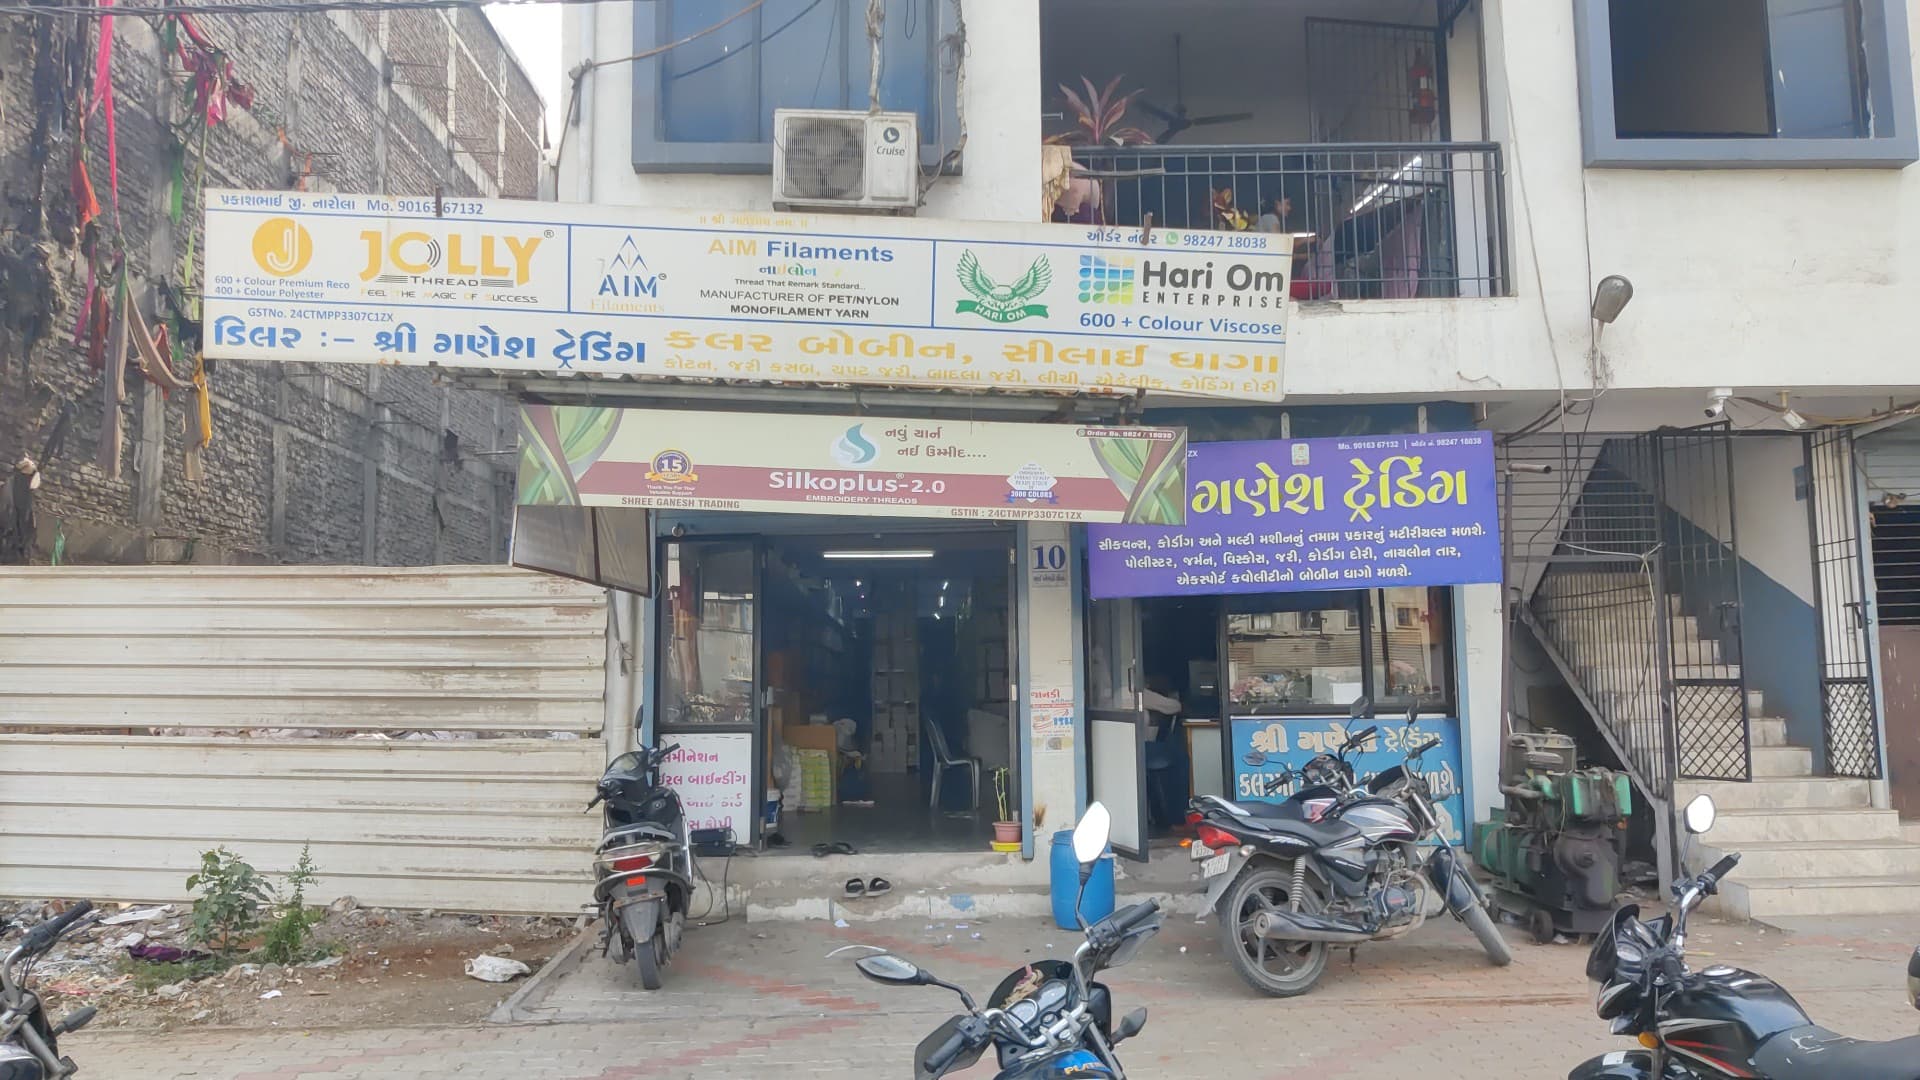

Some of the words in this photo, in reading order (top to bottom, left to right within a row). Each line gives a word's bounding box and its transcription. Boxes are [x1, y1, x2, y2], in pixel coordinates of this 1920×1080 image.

[876, 145, 906, 157] Cruise
[312, 196, 356, 210] નારોલા
[367, 199, 393, 212] Mo.
[443, 201, 484, 215] 67132
[1183, 234, 1224, 247] 98247
[1227, 236, 1268, 249] 18038
[359, 230, 544, 287] JOLLY
[707, 238, 758, 257] AIM
[767, 240, 895, 263] Filaments
[215, 275, 233, 284] 600
[243, 276, 277, 286] Colour
[279, 278, 324, 288] Premium
[326, 280, 350, 289] Reco
[409, 275, 479, 288] THREAD
[734, 278, 765, 287] Thread
[767, 279, 786, 288] That
[787, 280, 819, 290] Remark
[1142, 260, 1214, 290] Hari
[1226, 263, 1284, 293] Om
[215, 286, 233, 295] 400
[243, 287, 276, 297] Colour
[279, 288, 324, 299] Polyester
[598, 274, 657, 298] AIM
[700, 289, 805, 303] MANUFACTURER
[807, 293, 825, 304] OF
[828, 294, 900, 306] PET/NYLON
[1142, 291, 1284, 309] ENTERPRISE
[730, 305, 832, 317] MONOFILAMENT
[835, 308, 869, 319] YARN
[974, 304, 1003, 321] HARI
[1006, 309, 1027, 321] OM
[1079, 312, 1116, 329] 600
[1121, 316, 1133, 328] +
[1138, 314, 1204, 332] Colour
[1209, 317, 1283, 335] Viscose
[213, 315, 302, 349] ડિલર
[374, 322, 417, 353] શ્રી
[432, 325, 536, 359] ગણેશ
[552, 327, 646, 369] ટ્રેડિંગ
[664, 330, 774, 353] કલર
[799, 329, 974, 365] બોબીન,
[728, 358, 761, 373] જરી
[885, 424, 908, 442] નવું
[897, 444, 920, 457] નઈ
[661, 458, 683, 473] 15
[1190, 461, 1325, 517] ગણેશ
[1343, 455, 1468, 523] ટ્રેડિંગ
[621, 497, 653, 506] SHREE
[656, 498, 695, 507] GANESH
[698, 499, 740, 509] TRADING
[873, 496, 918, 505] THREADS
[951, 508, 979, 517] GSTIN
[987, 508, 1082, 520] 24CTMPP3307C1ZX
[1198, 533, 1222, 547] અને
[1227, 532, 1255, 546] મલ્ટી
[1259, 529, 1304, 547] મશીનનું
[1308, 531, 1340, 543] તમામ
[1344, 526, 1385, 544] પ્રકારનું
[1451, 522, 1487, 537] મળશે.
[1033, 544, 1066, 570] 10
[1182, 552, 1218, 568] જર્મન,
[1275, 549, 1302, 564] જરી,
[1350, 546, 1378, 561] દોરી,
[1383, 544, 1431, 560] નાયલોન
[1435, 546, 1462, 559] તાર,
[1298, 567, 1340, 582] બોબીન
[1343, 565, 1373, 580] ધાગો
[1376, 563, 1413, 578] મળશે.
[1250, 722, 1290, 753] શ્રી
